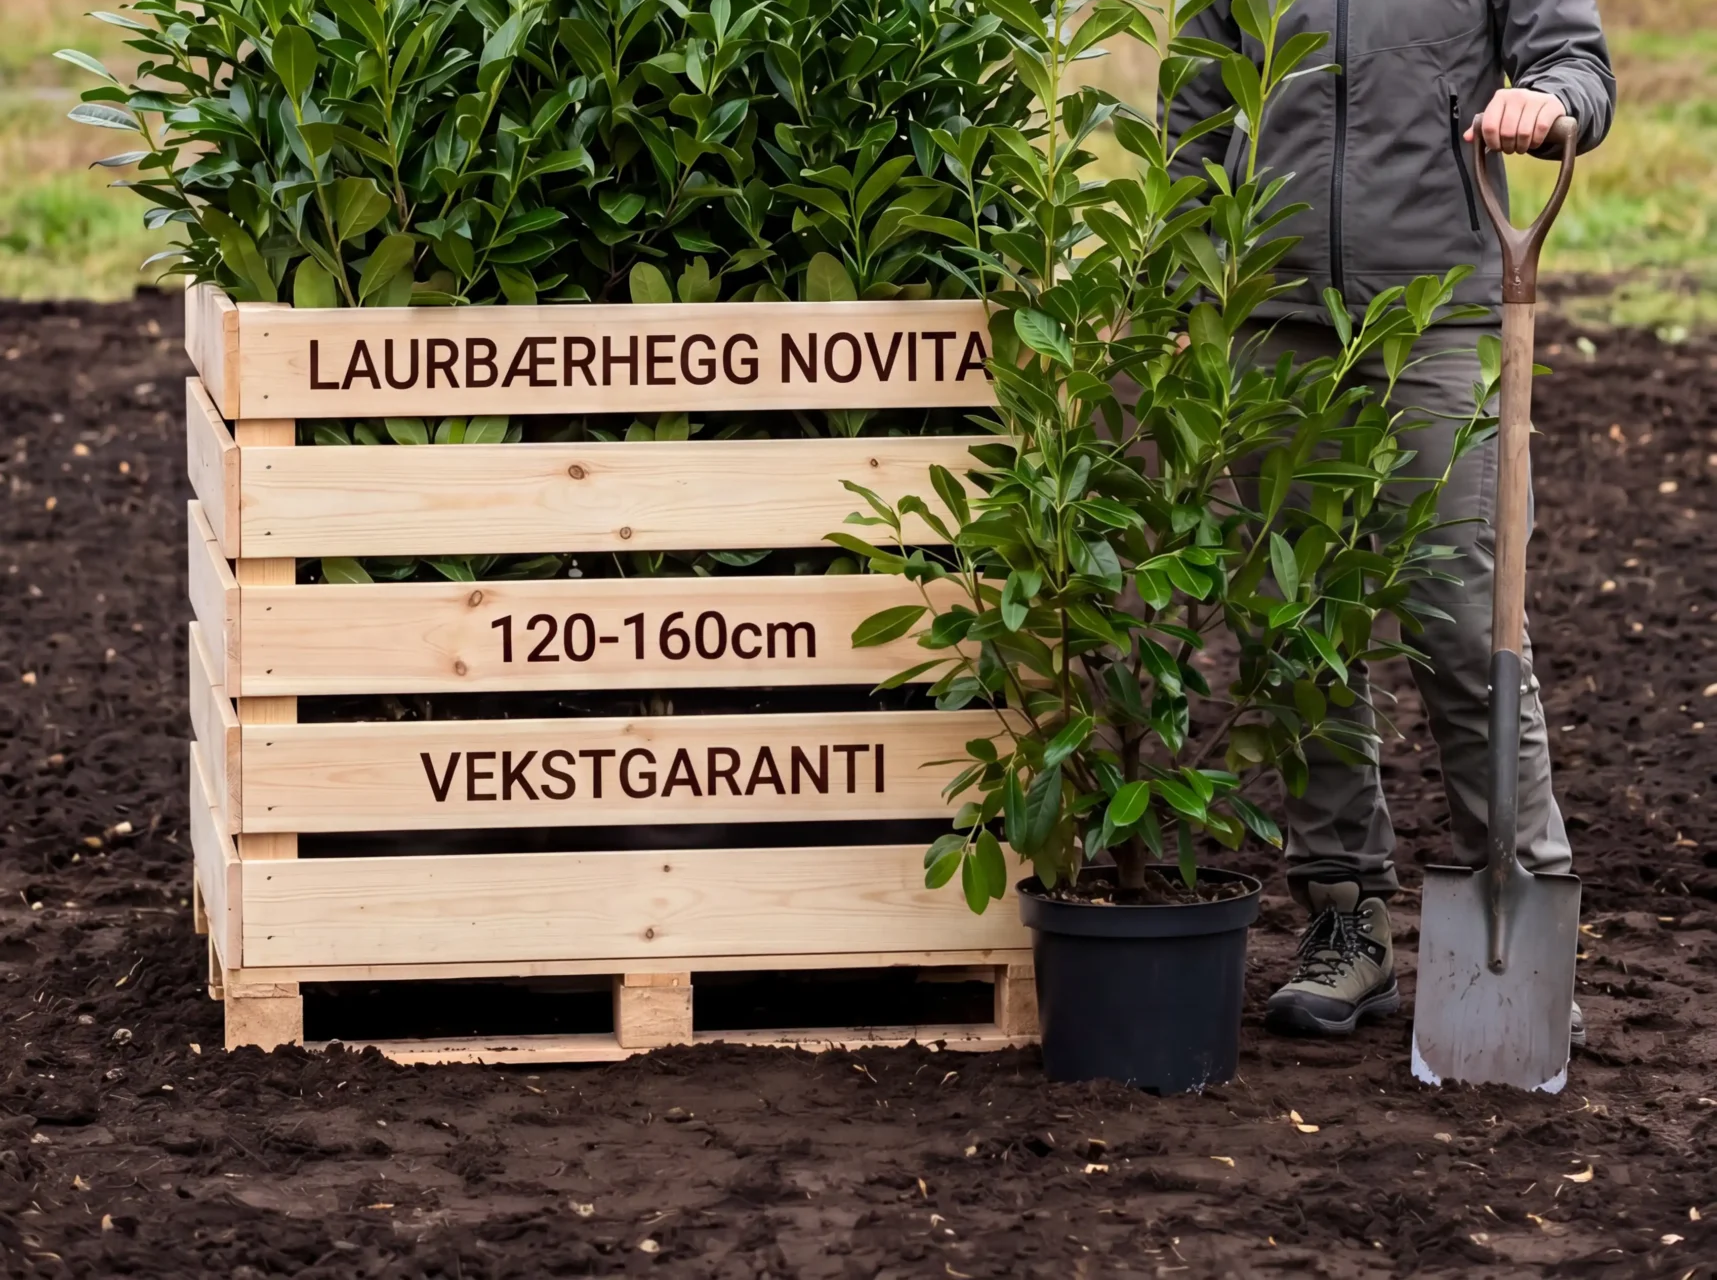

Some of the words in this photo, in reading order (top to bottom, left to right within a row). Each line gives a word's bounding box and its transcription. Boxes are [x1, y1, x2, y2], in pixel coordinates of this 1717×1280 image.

[309, 333, 759, 390] LAURBÆRHEGG
[781, 330, 995, 384] NOVITA
[491, 609, 816, 663] 120-160cm
[419, 743, 885, 803] VEKSTGARANTI
